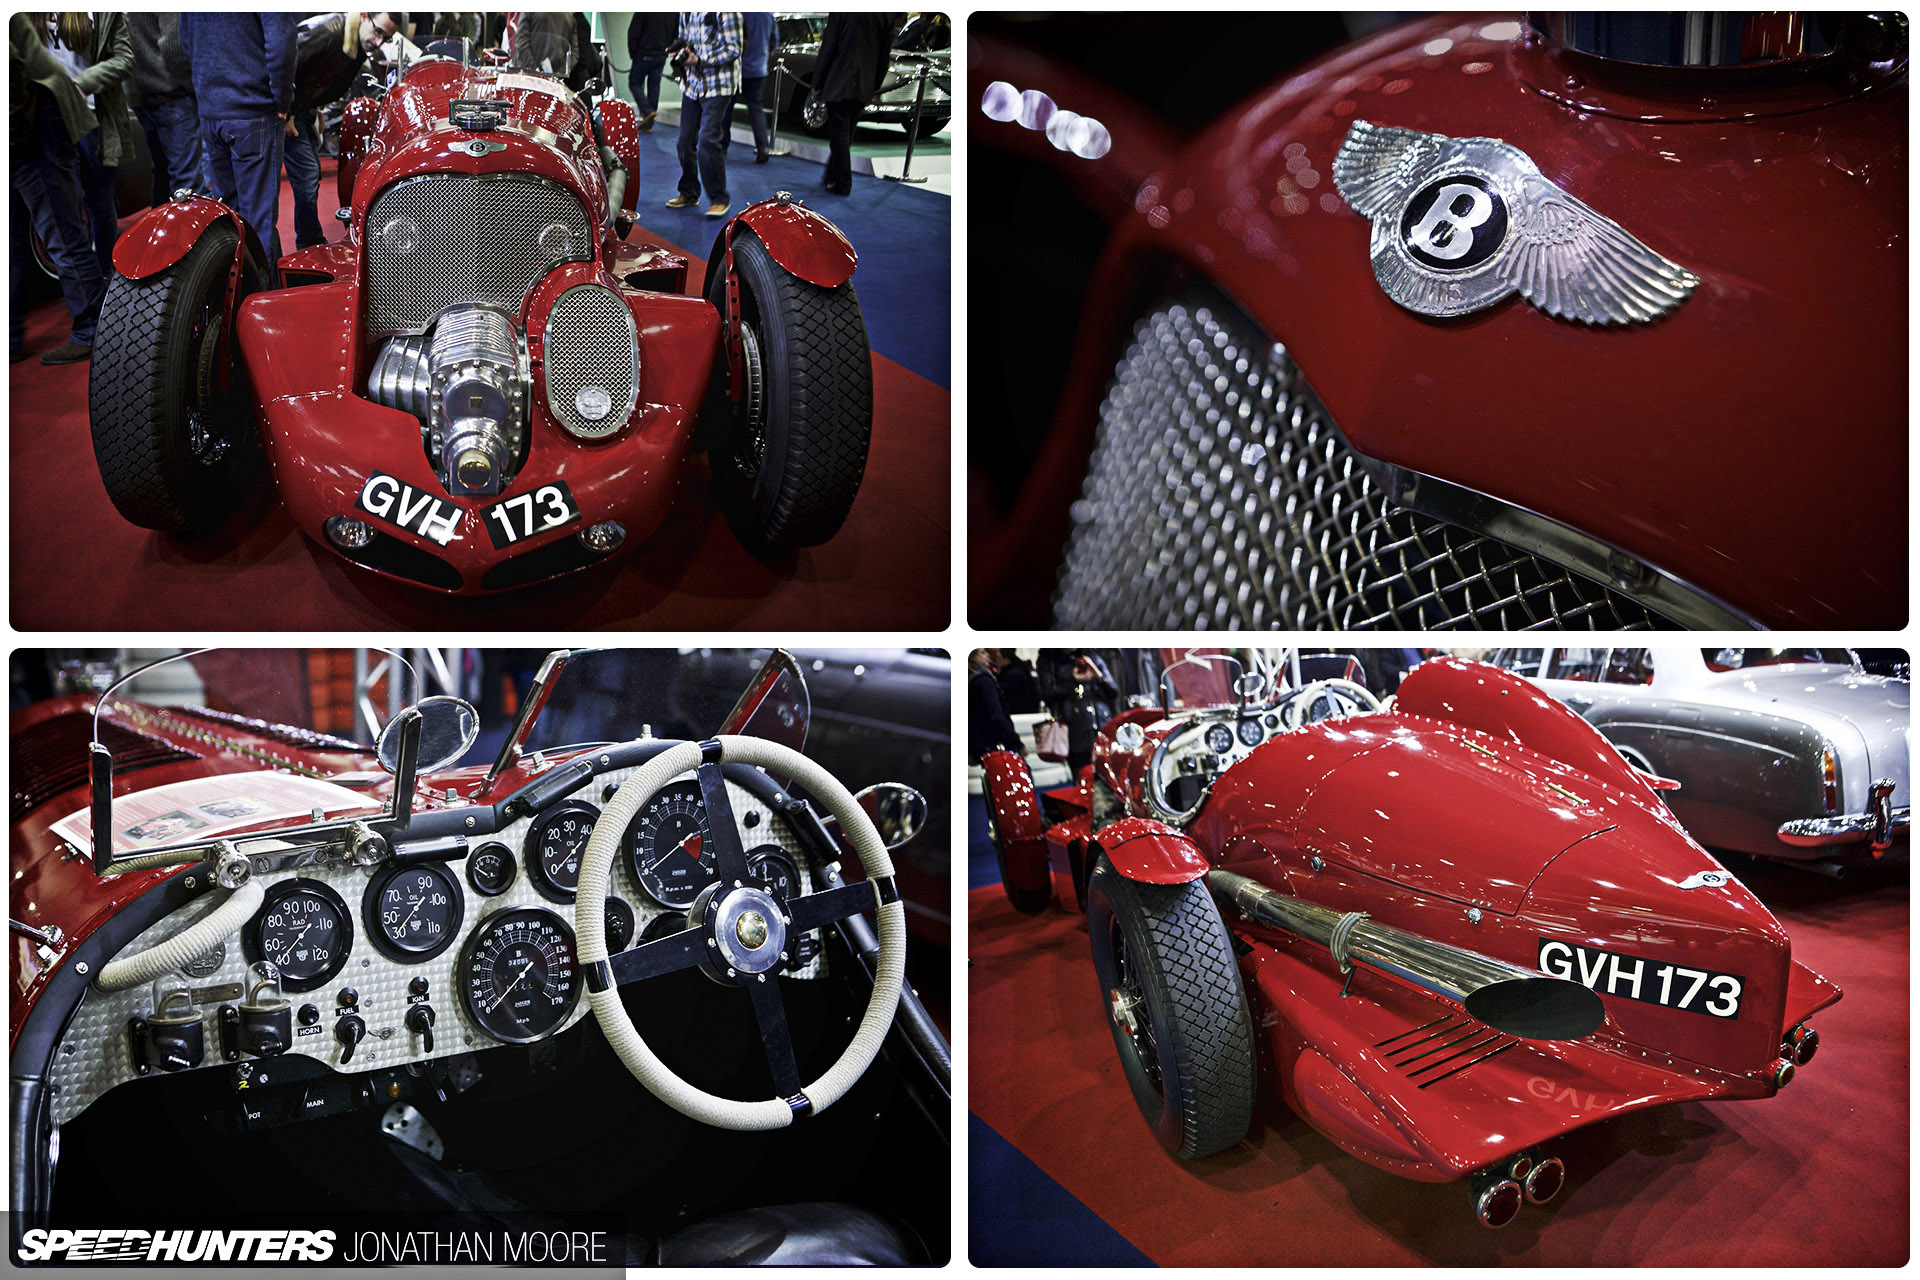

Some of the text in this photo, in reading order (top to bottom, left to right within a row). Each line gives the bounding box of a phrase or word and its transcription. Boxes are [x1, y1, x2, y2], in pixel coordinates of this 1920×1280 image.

[1408, 183, 1493, 260] B
[362, 475, 464, 547] GVH
[490, 486, 570, 543] 173
[661, 796, 670, 805] 30
[674, 793, 682, 801] 35
[686, 794, 694, 802] 40
[650, 804, 658, 813] 25
[641, 817, 650, 825] 20
[563, 820, 576, 832] 30
[580, 824, 592, 835] 40
[547, 828, 560, 840] 20
[544, 846, 554, 858] 10
[636, 847, 644, 855] 10
[551, 863, 558, 875] 0
[705, 867, 714, 875] 70
[417, 876, 433, 889] 90
[386, 889, 400, 903] 70
[431, 892, 447, 906] 100
[283, 901, 299, 915] 90
[303, 900, 321, 914] 100
[267, 914, 283, 928] 80
[383, 910, 398, 925] 50
[319, 917, 333, 930] 110
[428, 921, 440, 934] 110
[516, 921, 525, 929] 90
[528, 921, 540, 929] 100
[392, 926, 406, 939] 30
[550, 935, 562, 943] 120
[265, 938, 280, 952] 60
[556, 945, 568, 953] 130
[275, 953, 290, 965] 40
[312, 948, 329, 961] 120
[559, 956, 571, 964] 140
[472, 964, 481, 972] 40
[559, 970, 571, 978] 150
[472, 979, 480, 987] 30
[1539, 941, 1742, 1017] GVH 173
[557, 983, 569, 991] 160
[473, 990, 482, 998] 20
[412, 995, 424, 1003] IGN
[551, 997, 563, 1005] 170
[478, 1000, 487, 1008] 10
[340, 1007, 354, 1015] FUEL
[300, 1027, 320, 1035] HORN
[238, 1080, 250, 1090] 2
[306, 1099, 324, 1108] MAIN
